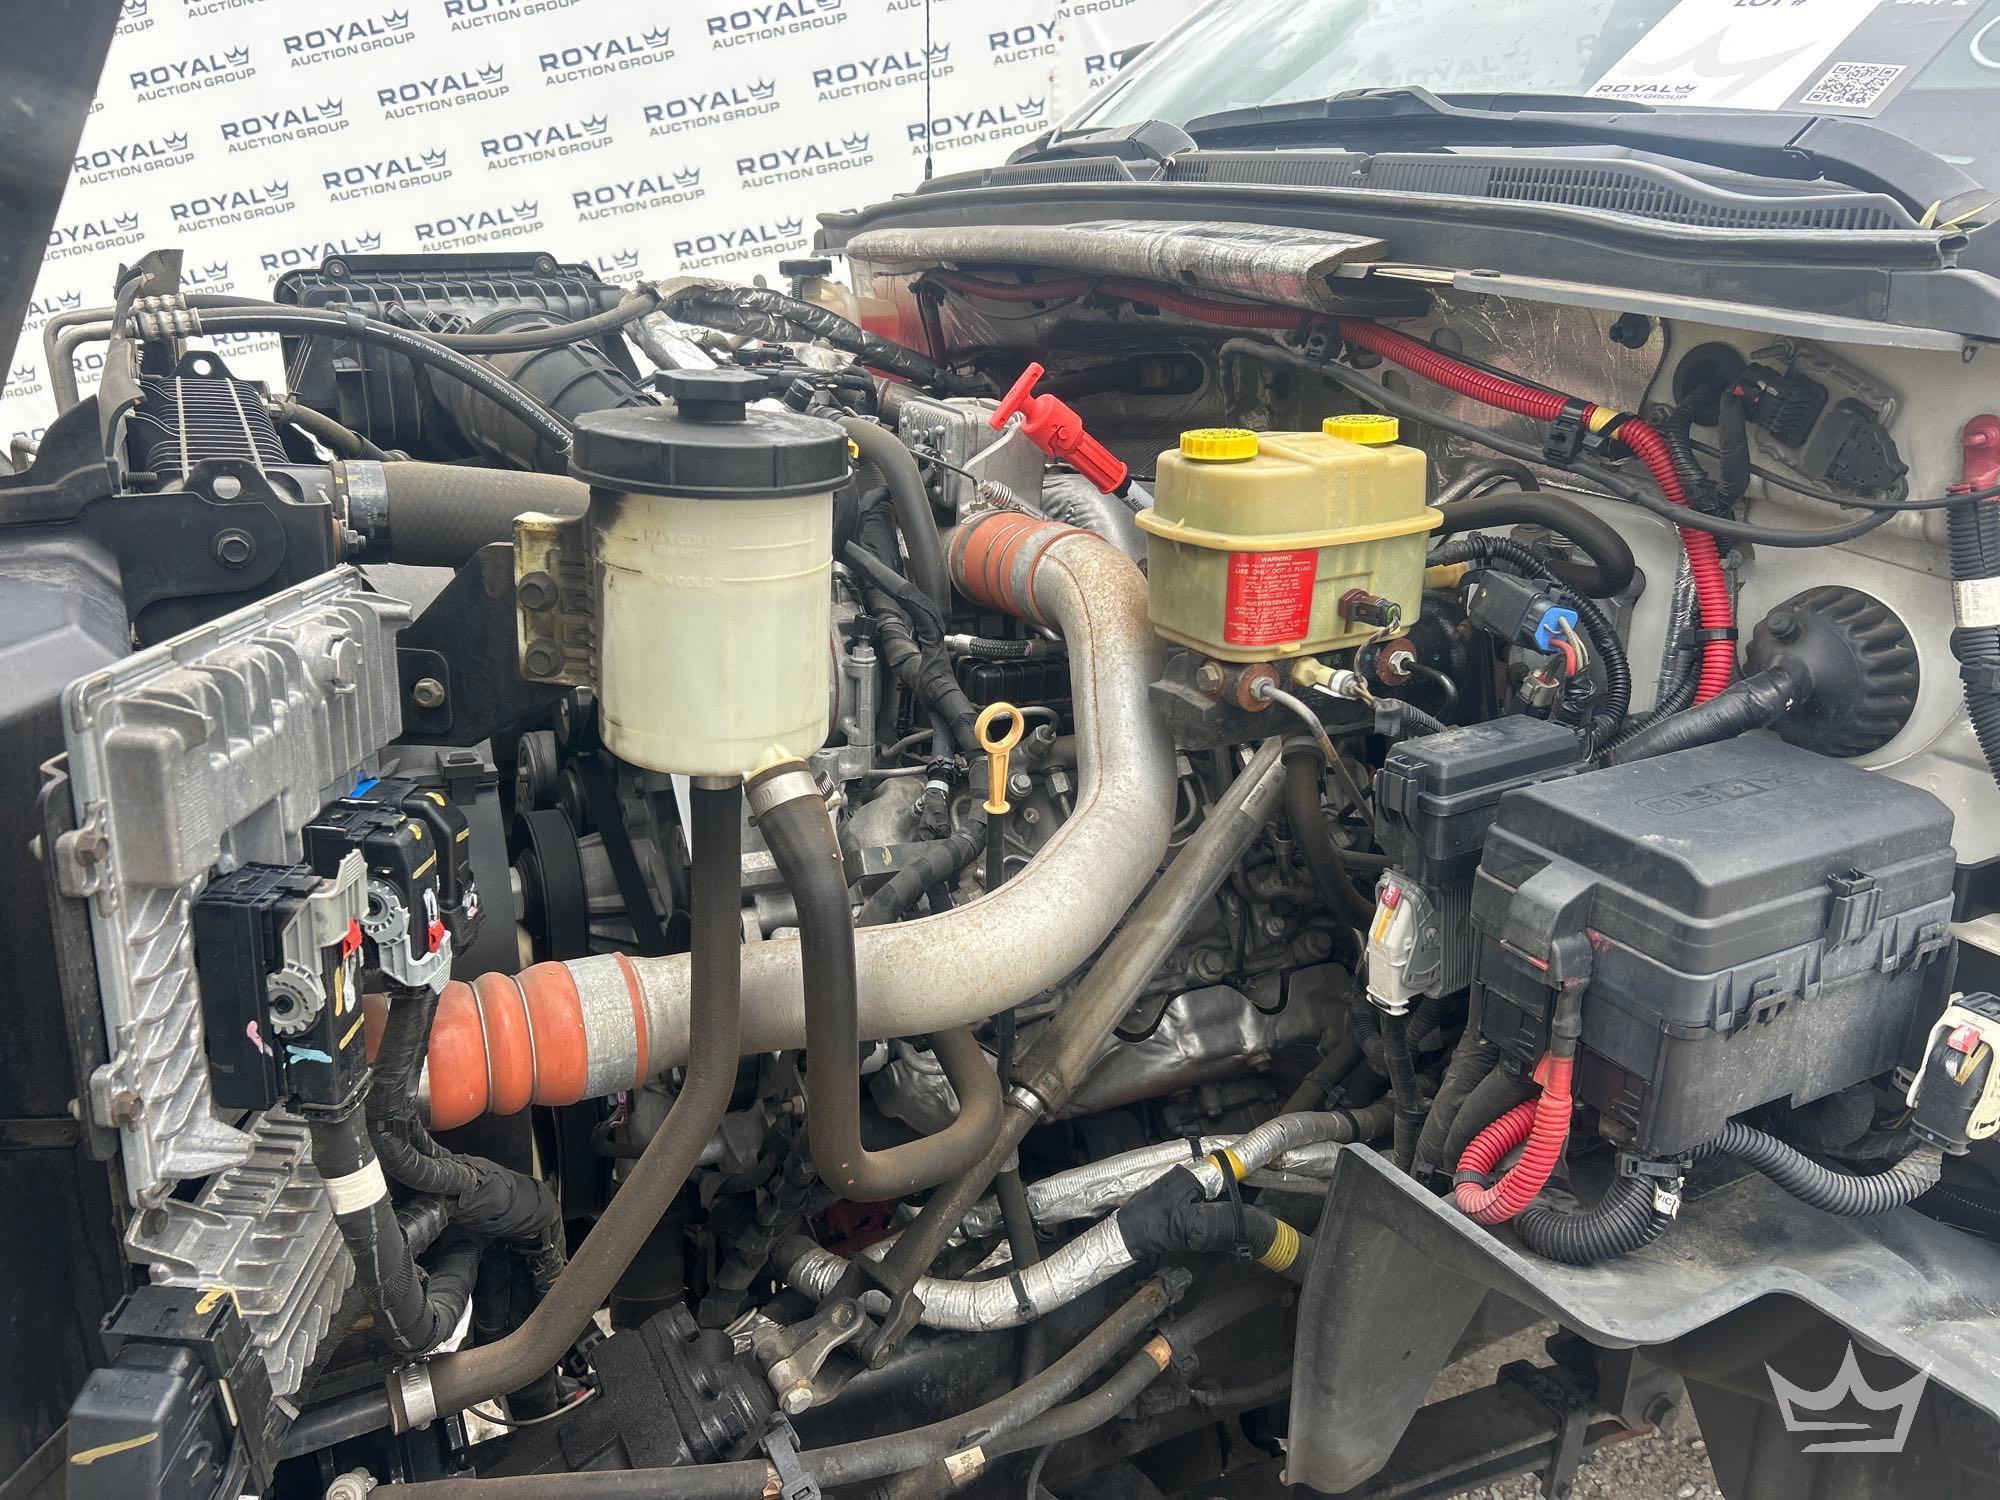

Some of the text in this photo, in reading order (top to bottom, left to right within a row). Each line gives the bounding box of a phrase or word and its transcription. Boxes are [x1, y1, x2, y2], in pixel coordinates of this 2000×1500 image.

[115, 19, 154, 37] ROUP
[451, 8, 521, 32] AUCTION
[707, 0, 816, 36] ROYAL
[712, 12, 847, 50] AUCTION GROUP
[989, 20, 1056, 50] ROY
[283, 18, 385, 54] ROYAL
[290, 32, 416, 68] AUCTION GROUP
[539, 36, 644, 72] ROYAL
[545, 50, 675, 86] AUCTION GROUP
[813, 52, 922, 88] ROYAL
[130, 54, 226, 89] ROYAL
[137, 67, 256, 102] AUCTION GROUP
[1596, 84, 1671, 93] ROYAL
[377, 72, 479, 107] ROYAL
[384, 86, 510, 121] AUCTION GROUP
[643, 88, 749, 124] ROYAL
[818, 78, 892, 102] AUCTION
[221, 106, 319, 140] ROYAL
[229, 119, 350, 153] AUCTION GROUP
[649, 101, 780, 137] AUCTION GROUP
[907, 106, 1017, 142] ROYAL
[989, 120, 1049, 140] GROUP
[74, 139, 166, 173] ROYAL
[481, 123, 583, 157] ROYAL
[487, 136, 613, 171] AUCTION GROUP
[79, 152, 195, 186] AUCTION GROUP
[322, 156, 423, 190] ROYAL
[736, 141, 843, 176] ROYAL
[742, 155, 874, 190] AUCTION GROUP
[329, 169, 453, 203] AUCTION GROUP
[572, 175, 675, 209] ROYAL
[170, 188, 266, 221] ROYAL
[177, 201, 295, 234] AUCTION GROUP
[578, 188, 705, 222] AUCTION GROUP
[48, 220, 116, 246] OYAL
[96, 232, 145, 250] GROUP
[415, 208, 514, 241] ROYAL
[422, 221, 544, 253] AUCTION GROUP
[674, 225, 778, 258] ROYAL
[680, 239, 808, 271] AUCTION GROUP
[602, 270, 644, 283] ROUP
[678, 533, 716, 546] COLD
[1261, 555, 1292, 563] WARNING
[676, 575, 714, 588] COLD
